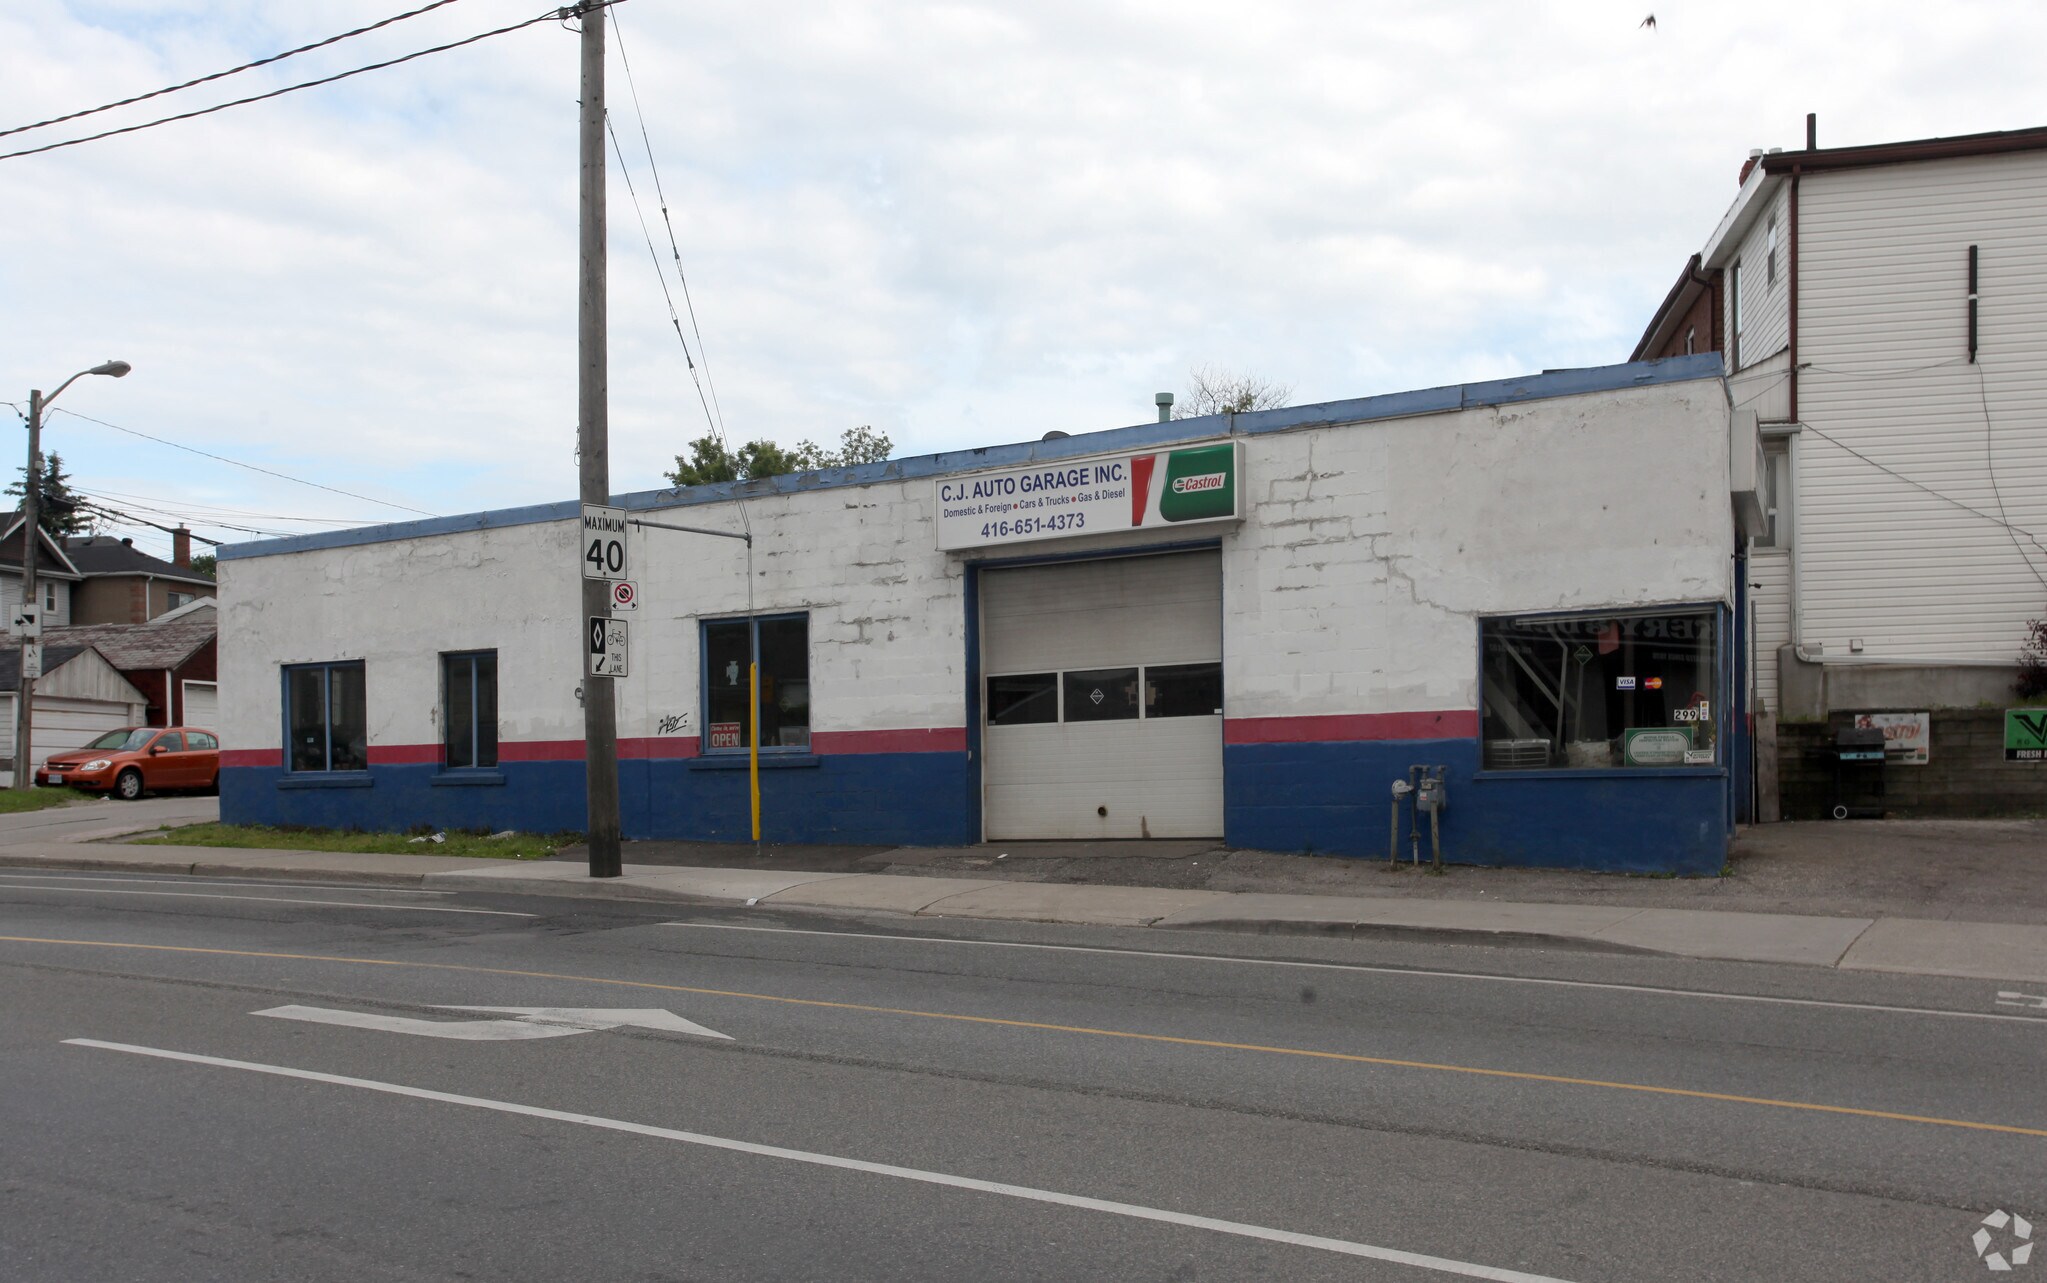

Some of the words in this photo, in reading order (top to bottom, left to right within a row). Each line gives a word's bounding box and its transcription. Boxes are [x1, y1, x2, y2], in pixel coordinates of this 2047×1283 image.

[941, 484, 968, 502] C.J.
[972, 477, 1015, 499] AUTO
[1020, 467, 1089, 492] GARAGE
[1095, 463, 1127, 484] INC.
[1185, 474, 1221, 491] Castrol
[943, 506, 976, 518] Domestic
[978, 505, 983, 514] &
[985, 502, 1012, 514] Foreign
[1019, 499, 1036, 509] Cars
[1038, 498, 1043, 507] &
[1045, 495, 1070, 506] Trucks
[1078, 492, 1092, 502] Gas
[1094, 491, 1100, 500] &
[1102, 488, 1125, 500] Diesel
[584, 515, 625, 533] MAXIMUM
[981, 512, 1085, 538] 416-651-4373
[586, 539, 624, 573] 40
[611, 653, 622, 662] THIS
[609, 664, 623, 673] LANE
[1675, 710, 1696, 720] 299
[712, 733, 739, 747] OPEN
[2016, 750, 2041, 759] FRESH
